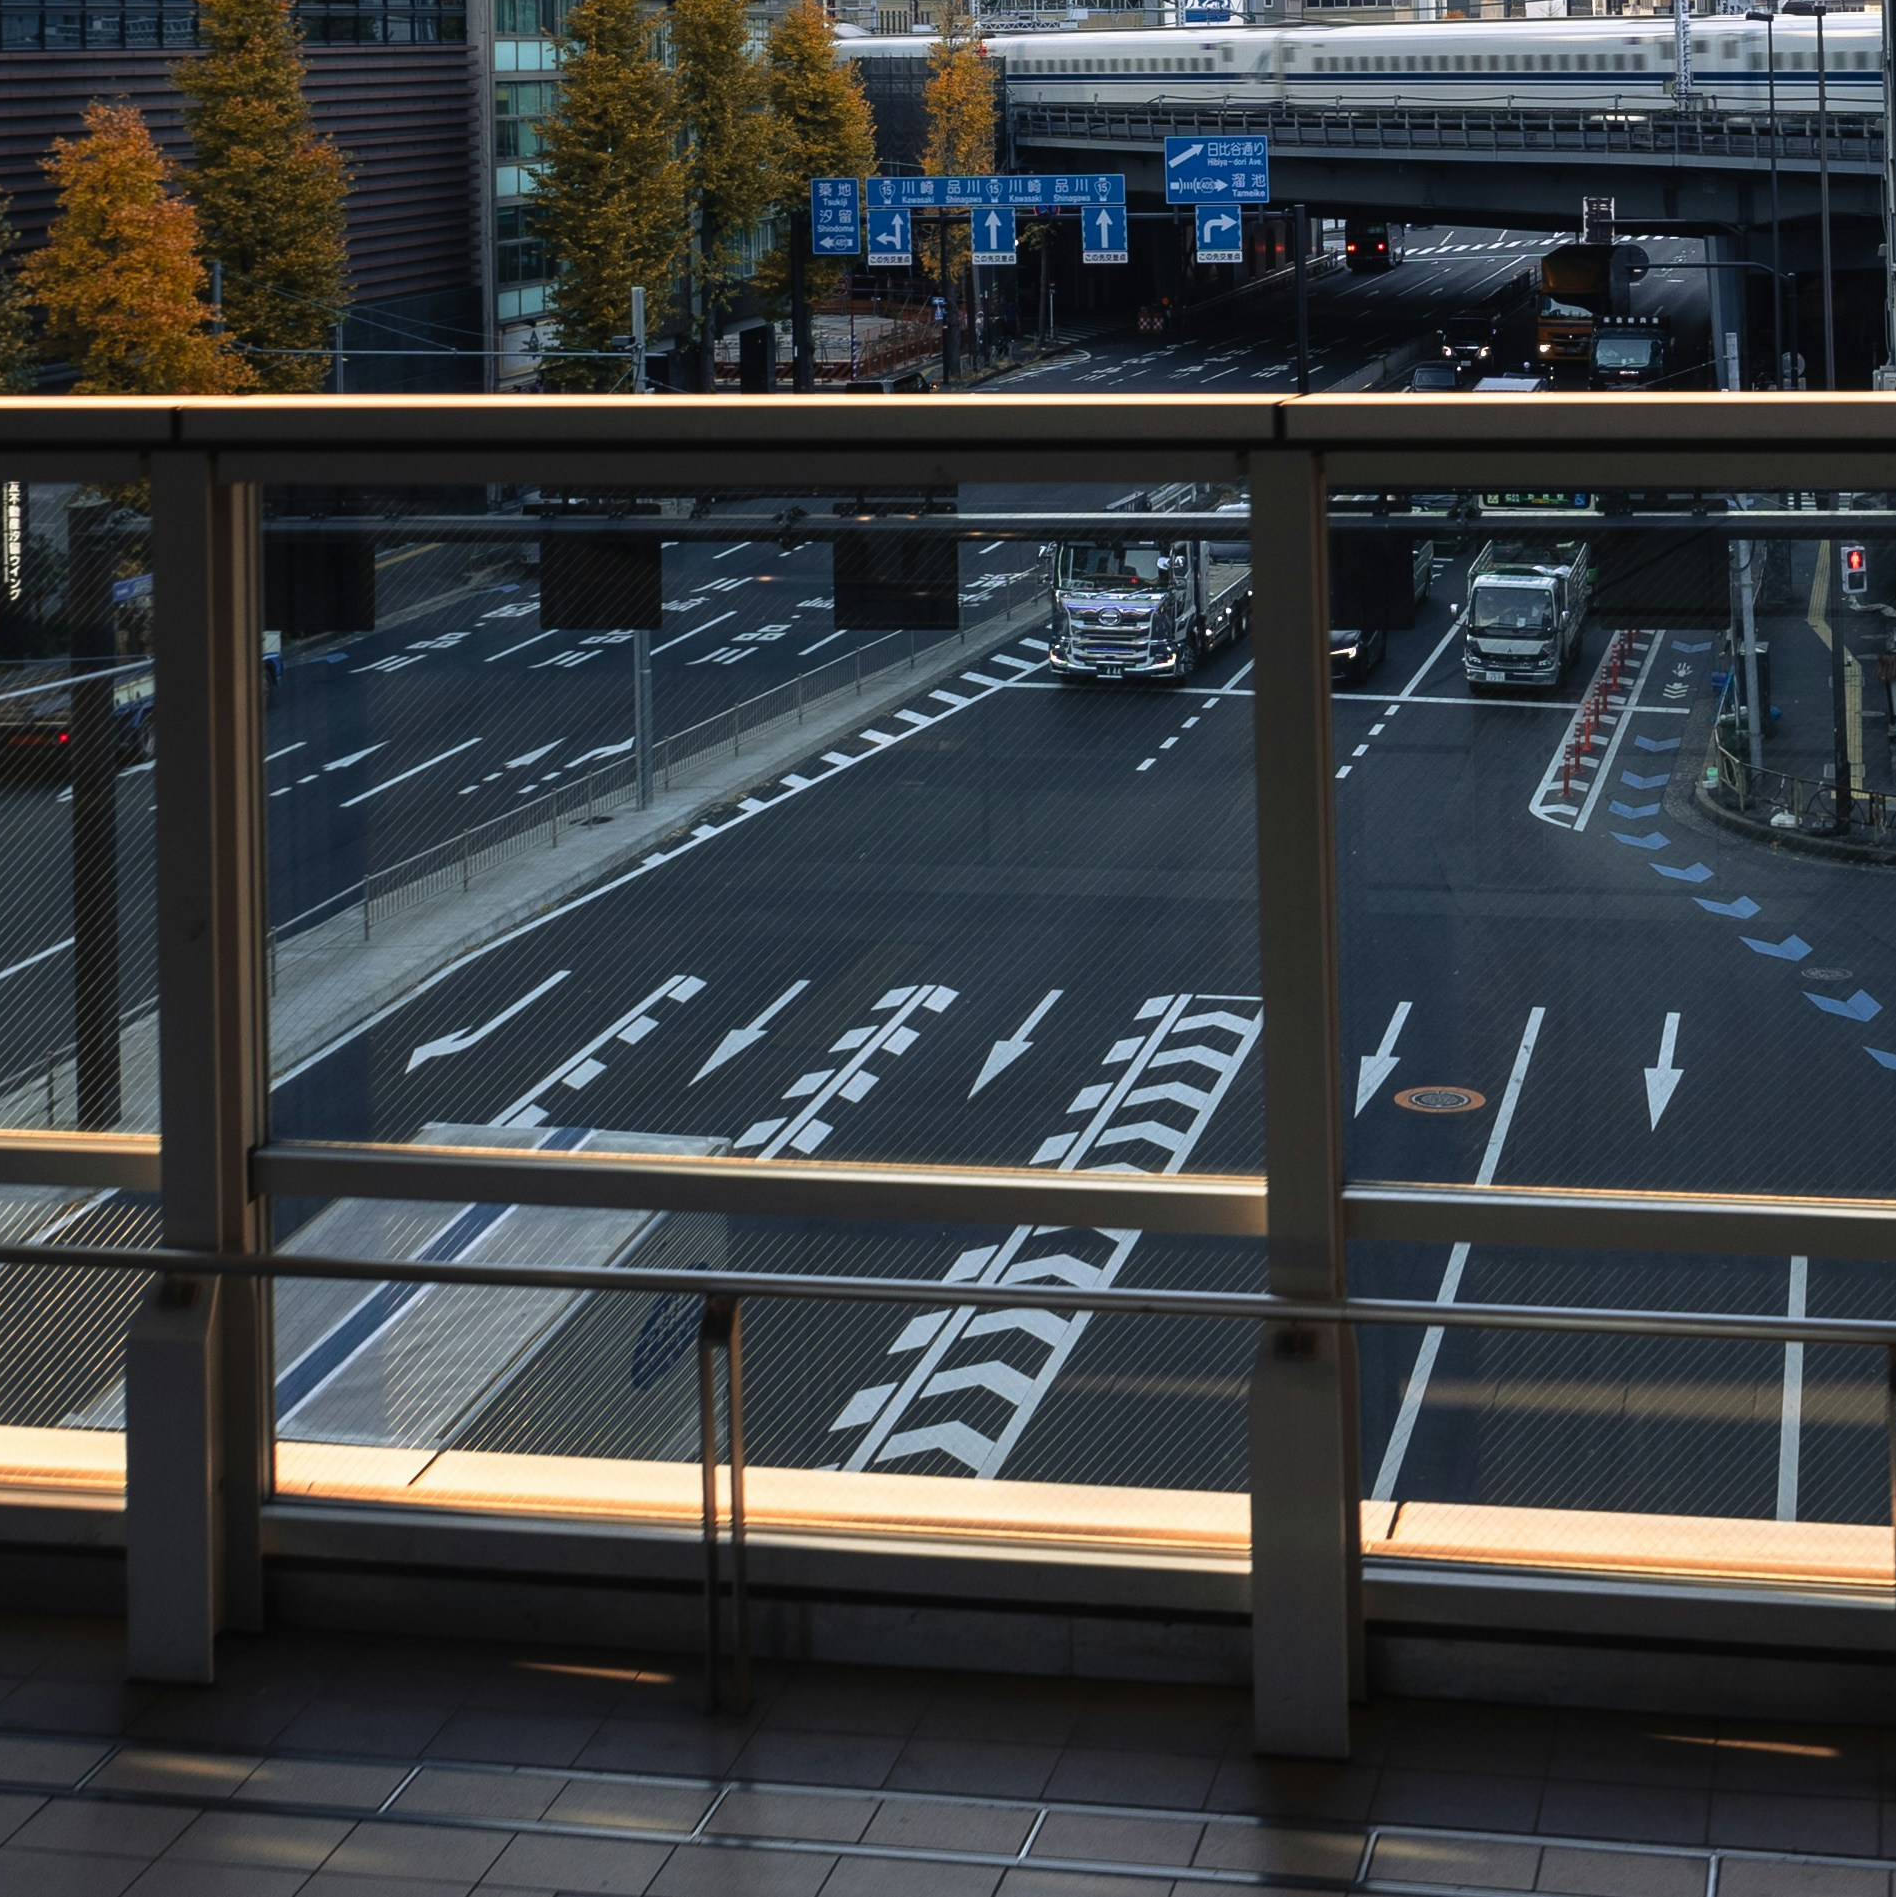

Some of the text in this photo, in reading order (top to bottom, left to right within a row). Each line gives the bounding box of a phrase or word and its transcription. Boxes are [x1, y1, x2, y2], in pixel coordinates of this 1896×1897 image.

[1207, 142, 1264, 157] 日比谷通り
[1248, 158, 1264, 166] Ave.
[1055, 178, 1089, 193] 品川
[1231, 173, 1266, 188] 溜池
[818, 183, 852, 197] 築地
[882, 186, 893, 196] 15
[901, 180, 934, 195] 川崎
[947, 179, 981, 195] 品川
[989, 184, 1000, 194] 15
[1008, 179, 1041, 194] 川崎
[1097, 183, 1108, 193] 15
[823, 198, 848, 207] Tsukiji
[901, 196, 935, 204] Kawasaki
[945, 195, 983, 205] Shinagawa
[1008, 194, 1042, 203] Kawasaki
[1053, 194, 1091, 203] Shinagawa
[819, 209, 852, 223] 汐留
[817, 225, 855, 233] Shiodome
[869, 255, 911, 264] この先交差点
[973, 254, 1015, 263] この先交差点
[1085, 253, 1127, 262] この先交差点
[1198, 253, 1242, 261] この先交差点
